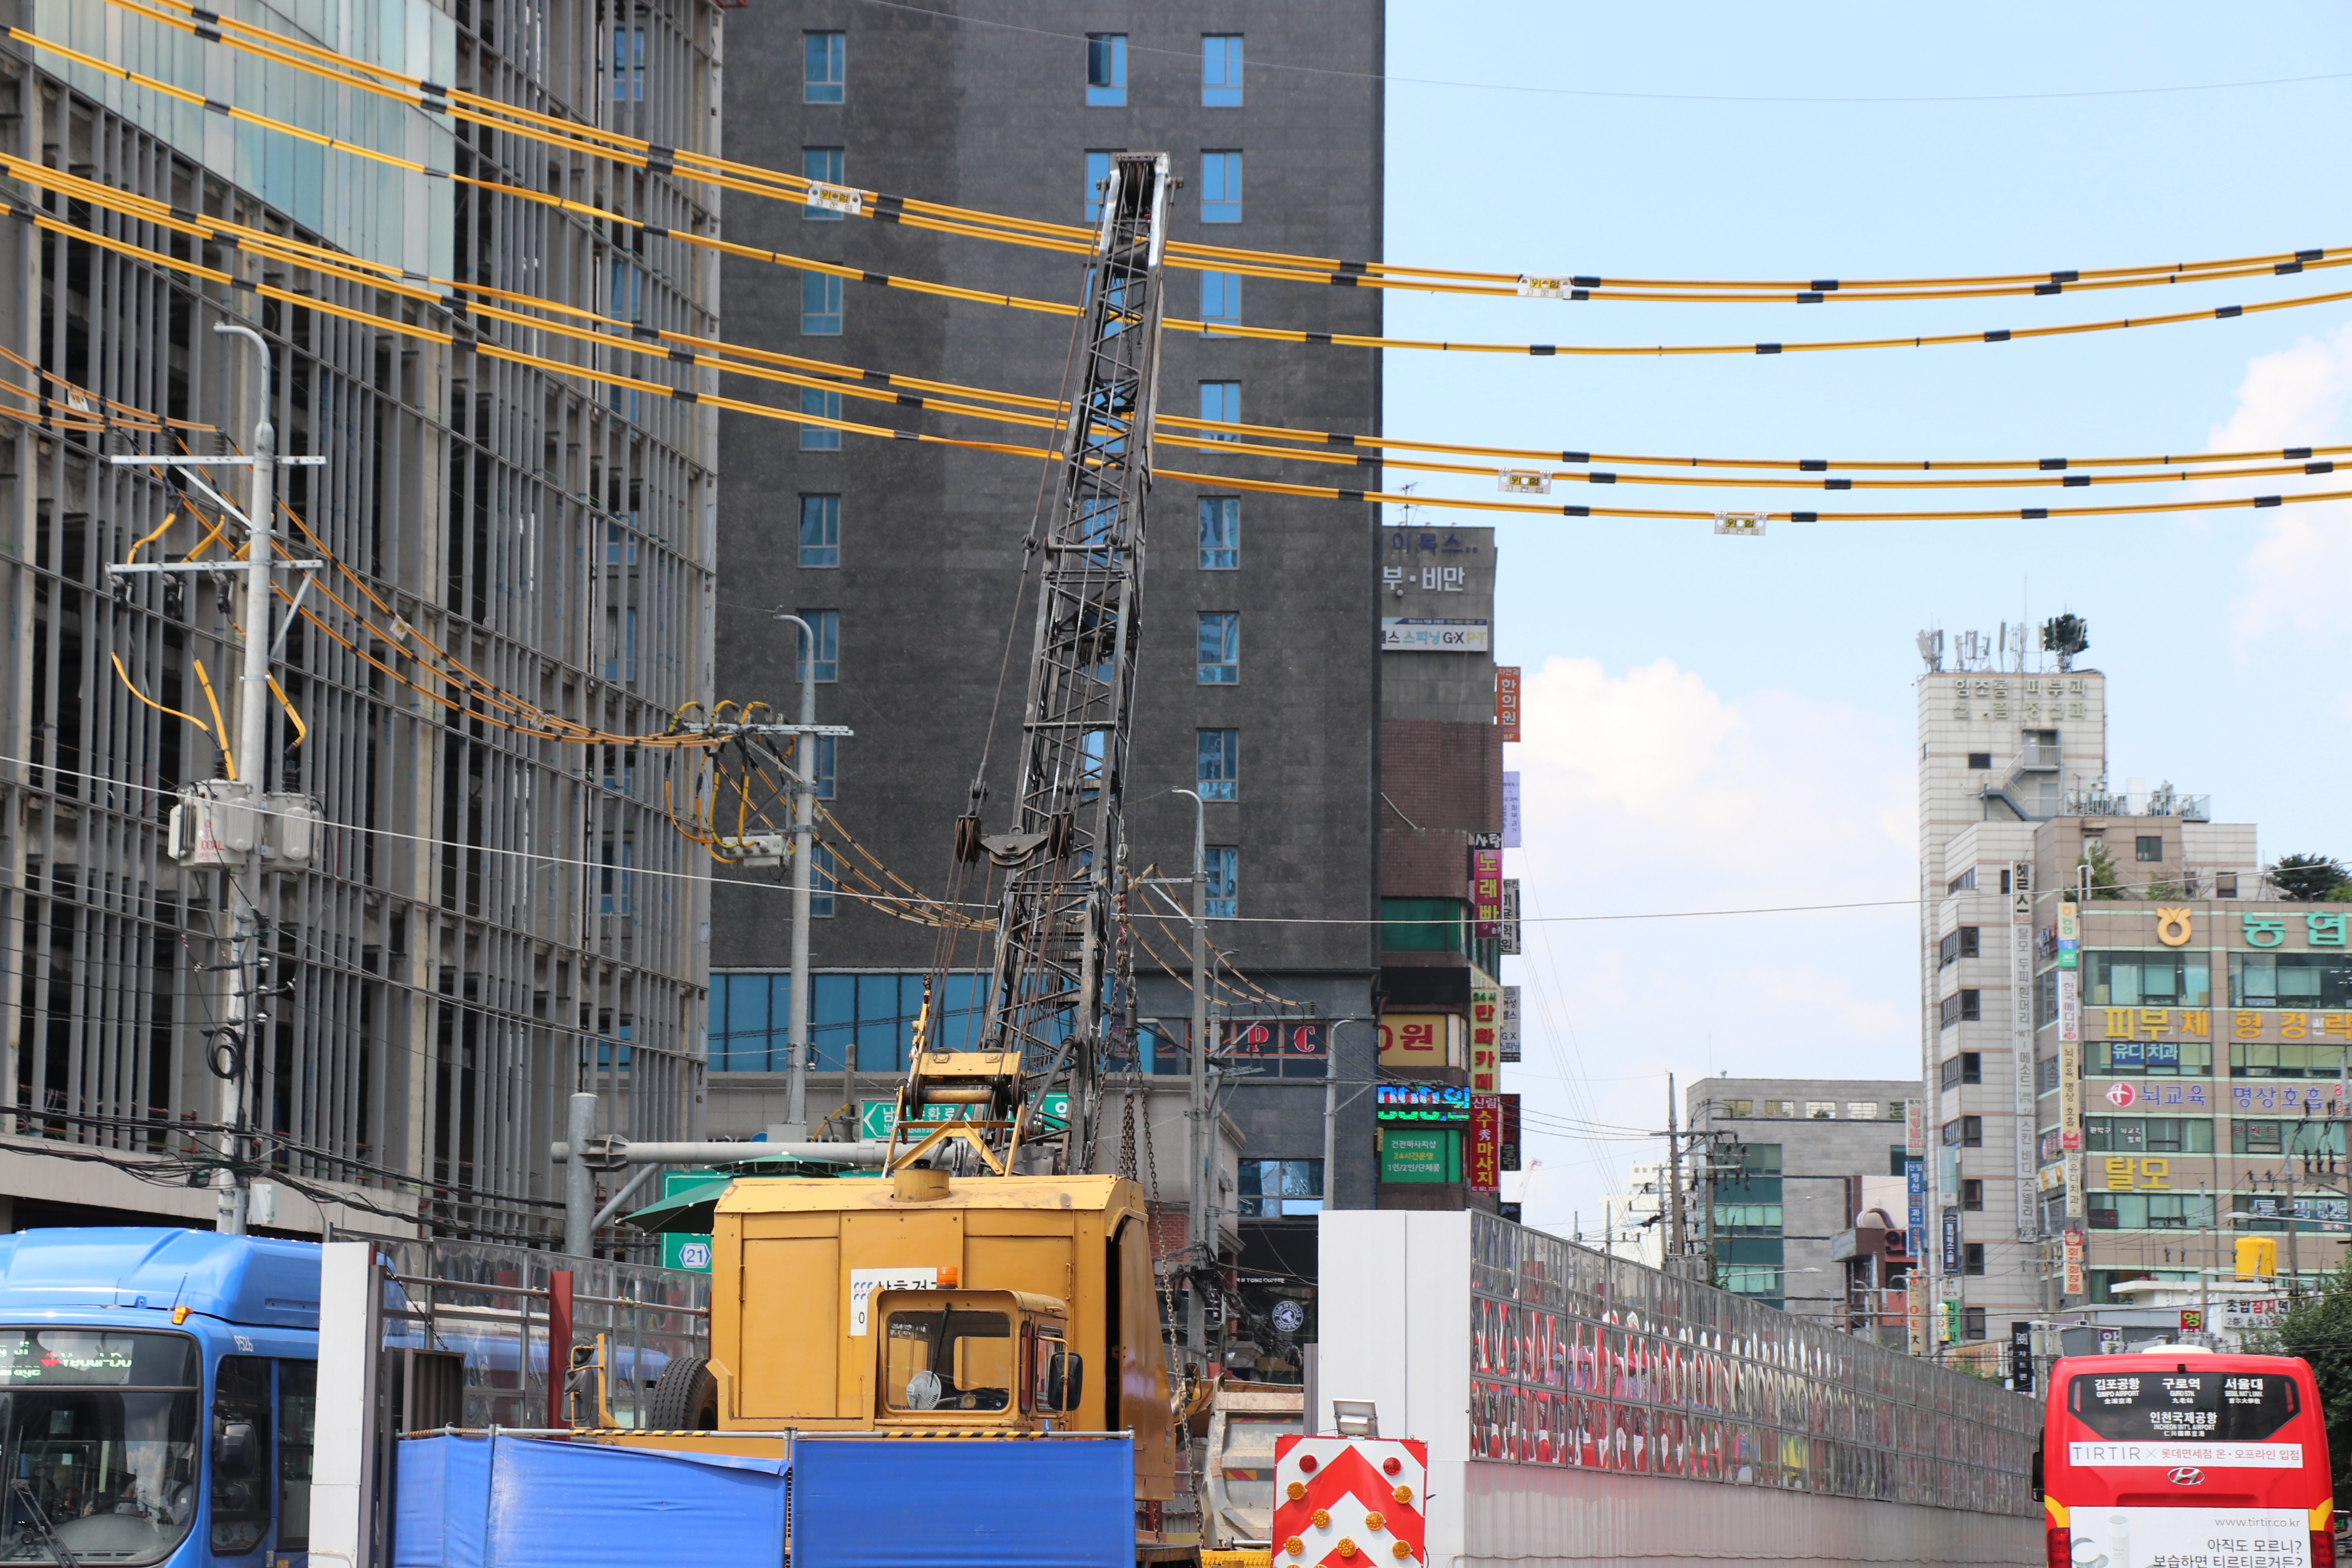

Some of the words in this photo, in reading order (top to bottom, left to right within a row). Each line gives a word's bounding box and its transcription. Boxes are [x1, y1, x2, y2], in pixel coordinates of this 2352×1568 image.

[814, 198, 853, 211] 고전압
[1403, 631, 1440, 645] 스피닝
[2027, 680, 2086, 697] 피부과
[1501, 678, 1517, 726] 한의원
[1478, 852, 1500, 924] 노래빠
[2242, 910, 2348, 948] 농협
[2104, 1008, 2170, 1041] 피부
[2181, 1010, 2262, 1039] 체형
[2280, 1011, 2352, 1040] 경락
[1474, 1004, 1495, 1090] 만화카페
[1472, 1097, 1497, 1109] 신림
[2141, 1084, 2207, 1108] 뇌교육
[883, 1107, 955, 1122] 남환로
[1476, 1142, 1494, 1186] 마사지
[2105, 1157, 2171, 1191] 탈모
[2069, 1164, 2079, 1204] 유디치과
[686, 1249, 703, 1263] 21
[1276, 1319, 1300, 1329] COFFEE
[2095, 1377, 2141, 1391] 김포공항
[2161, 1377, 2201, 1390] 구로역
[2224, 1378, 2264, 1391] 서울대
[2150, 1412, 2218, 1425] 인천국제공항
[2072, 1446, 2141, 1461] TIRTIR
[2161, 1448, 2213, 1461] 롯데면세점
[2279, 1449, 2300, 1461] 입점
[2214, 1517, 2301, 1527] www.tirtir.co.kr
[2207, 1538, 2250, 1553] 아직도
[2253, 1540, 2302, 1554] 모르니?
[2154, 1554, 2208, 1568] 보습하면
[2213, 1554, 2304, 1568] 티르티르거든?
